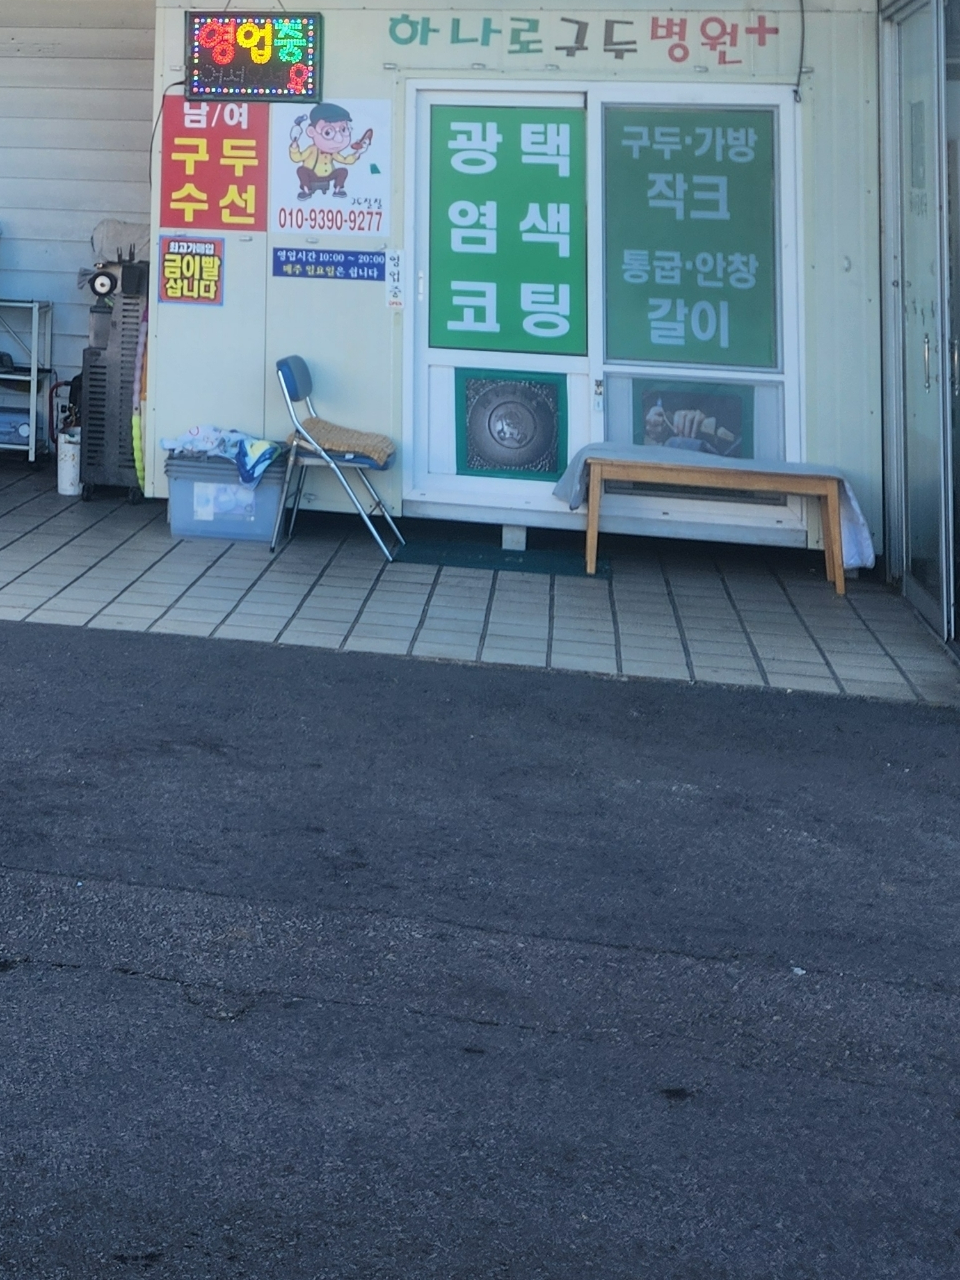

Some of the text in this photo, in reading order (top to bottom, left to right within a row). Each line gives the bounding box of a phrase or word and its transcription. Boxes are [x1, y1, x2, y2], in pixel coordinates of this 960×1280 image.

[198, 18, 307, 65] 영업중
[184, 102, 248, 129] 남/여
[171, 137, 259, 177] 구두
[447, 121, 571, 178] 광택
[169, 184, 257, 224] 수선
[646, 173, 731, 221] 작크
[278, 208, 383, 231] 010-9390-9277
[447, 200, 571, 258] 염색
[164, 254, 221, 280] 금이빨
[277, 250, 316, 263] 영업시간
[319, 252, 345, 261] 10:00
[357, 254, 385, 264] 20:00
[305, 265, 346, 277] 일요일은
[165, 278, 217, 299] 삽니다
[446, 280, 571, 338] 코팅
[647, 298, 730, 348] 갈이
